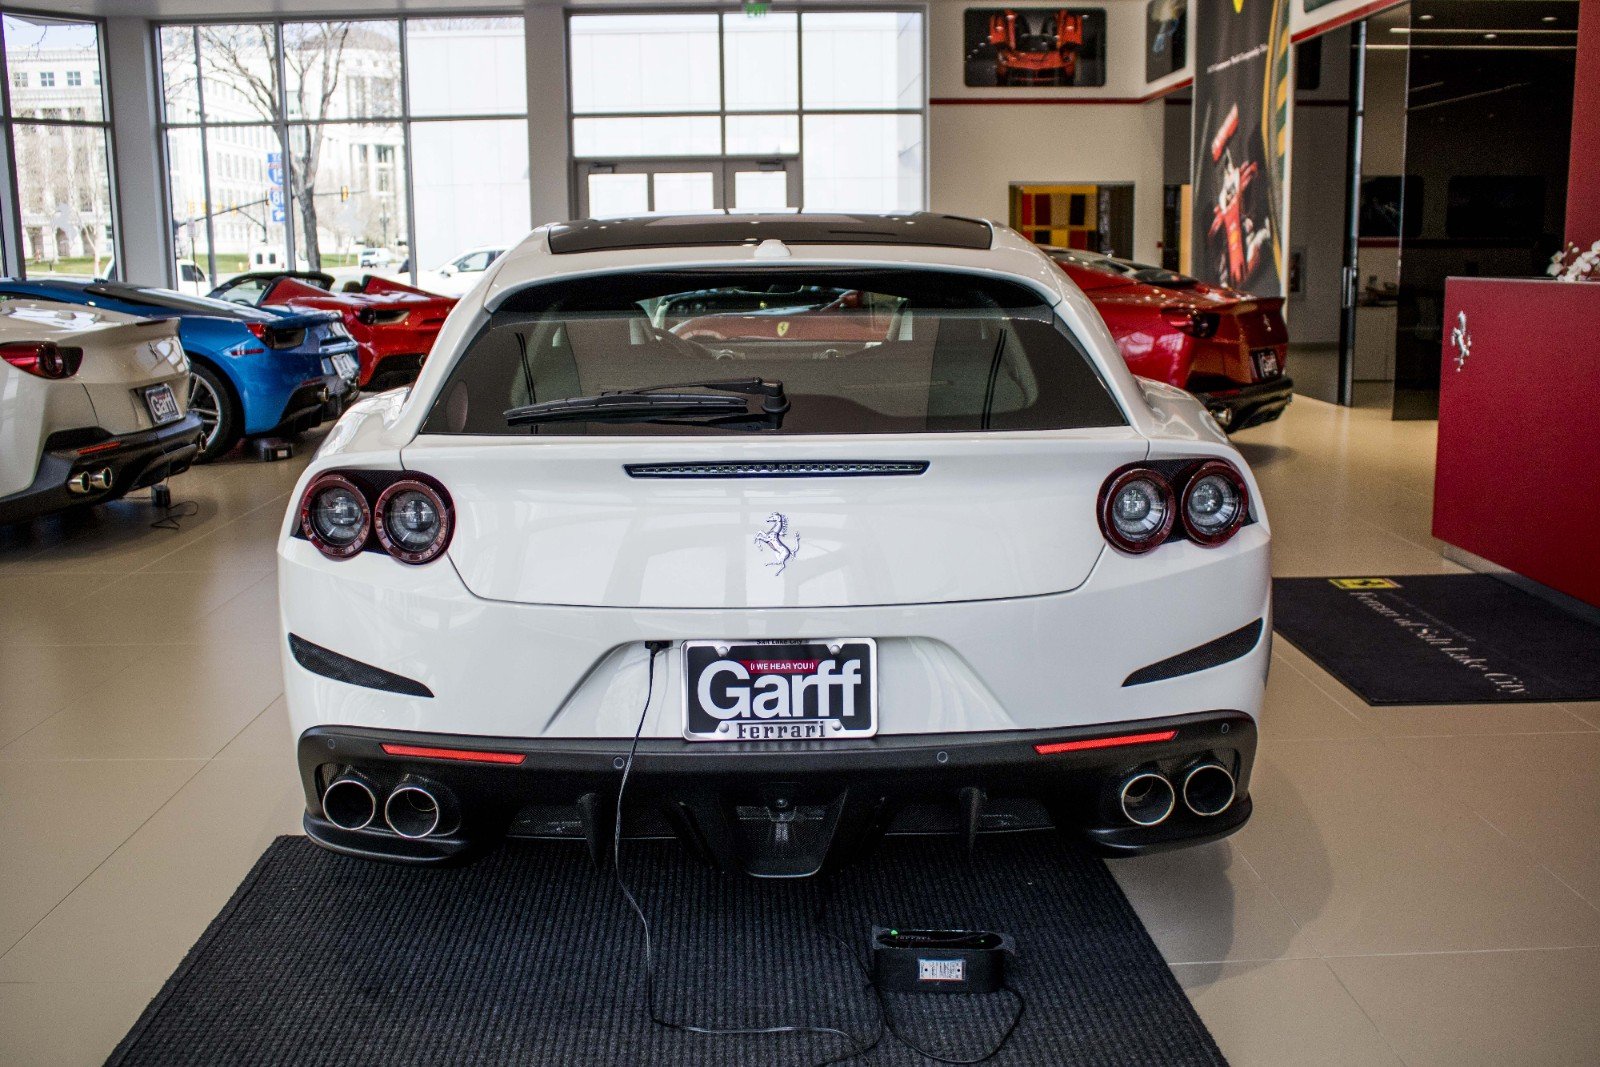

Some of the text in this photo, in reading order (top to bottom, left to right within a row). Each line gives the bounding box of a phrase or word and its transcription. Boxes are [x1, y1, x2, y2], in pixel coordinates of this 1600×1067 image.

[756, 662, 809, 670] WE HEAR YOU
[697, 659, 862, 720] Garff
[736, 720, 826, 739] Ferrari
